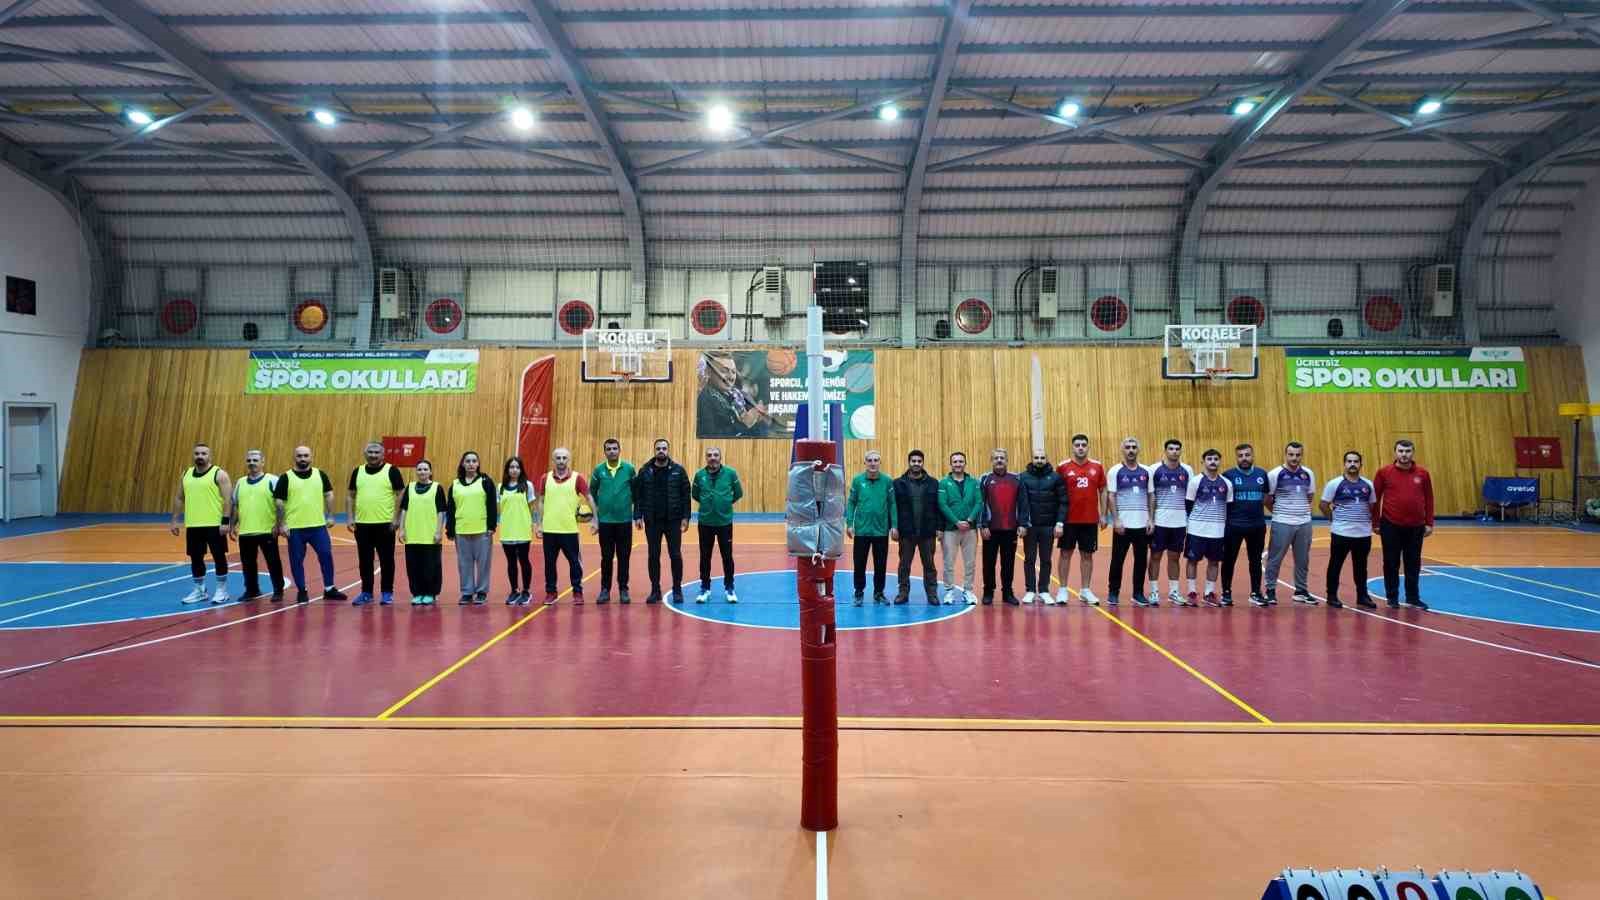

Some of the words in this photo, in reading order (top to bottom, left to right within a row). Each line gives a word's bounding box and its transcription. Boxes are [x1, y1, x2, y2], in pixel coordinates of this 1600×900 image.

[255, 369, 327, 390] SPOR
[331, 368, 469, 391] OKULLARI
[1295, 367, 1373, 389] SPOR
[1375, 367, 1518, 389] OKULLARI
[769, 391, 780, 401] VE
